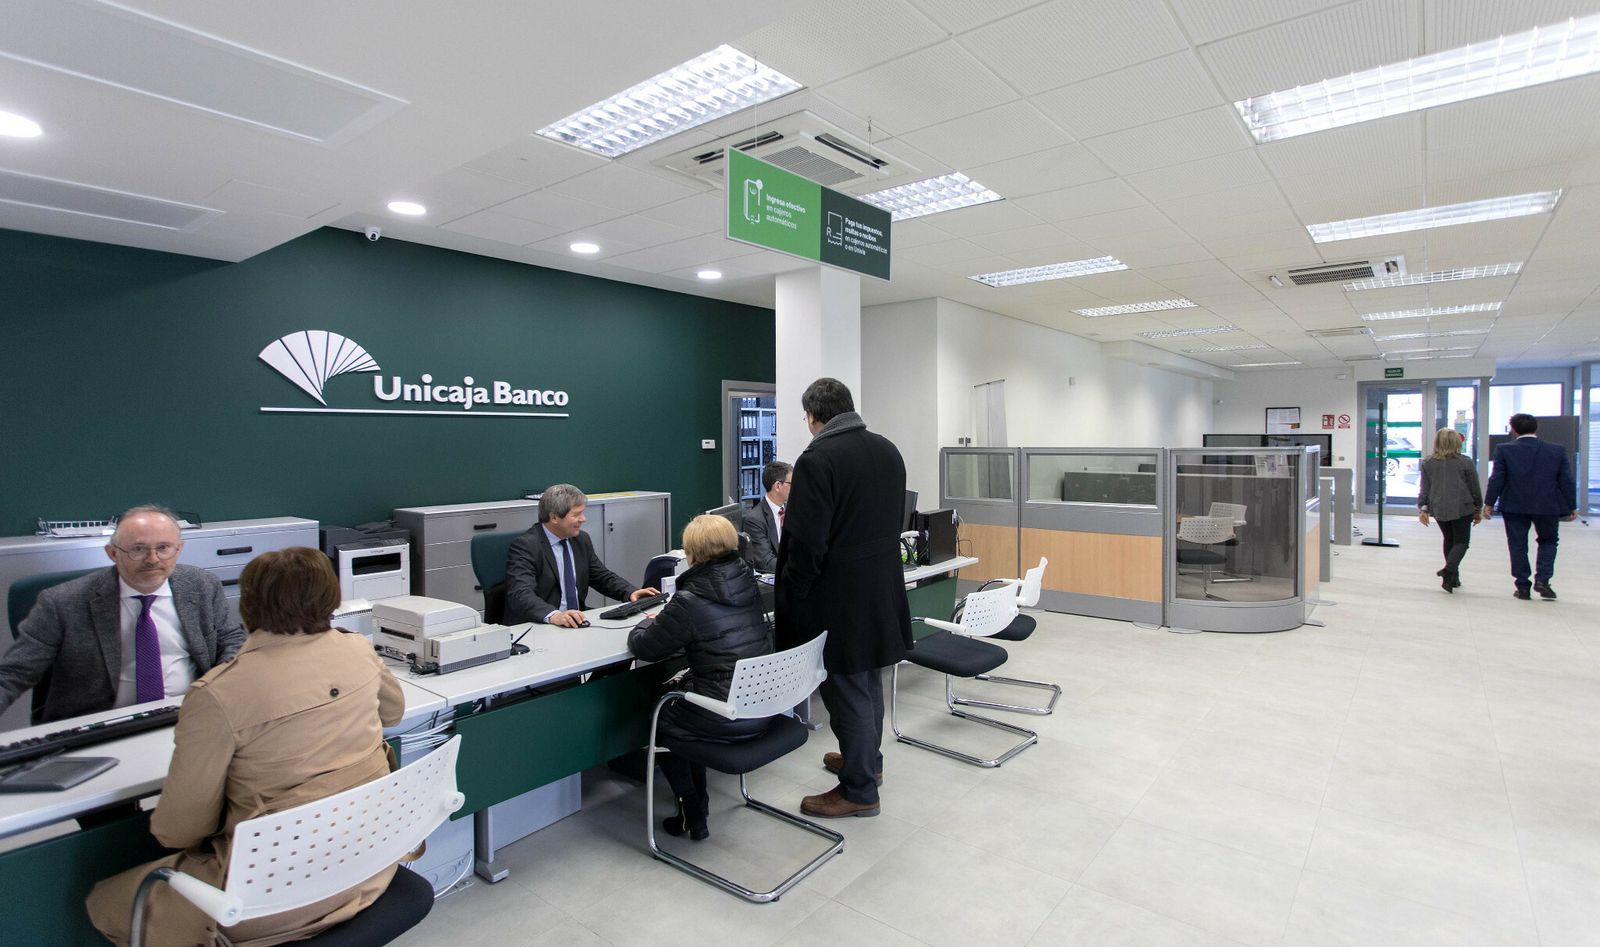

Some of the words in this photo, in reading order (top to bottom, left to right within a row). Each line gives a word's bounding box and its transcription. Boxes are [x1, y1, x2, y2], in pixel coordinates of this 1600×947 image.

[766, 204, 773, 212] en
[774, 207, 791, 218] cajeros
[786, 201, 806, 213] efectivo
[766, 214, 797, 229] automáticos
[845, 227, 859, 237] multas
[862, 233, 877, 243] recibos
[851, 237, 865, 247] cajeros
[865, 242, 888, 254] automáticos
[374, 374, 490, 410] Unicaja
[493, 381, 569, 406] Banco
